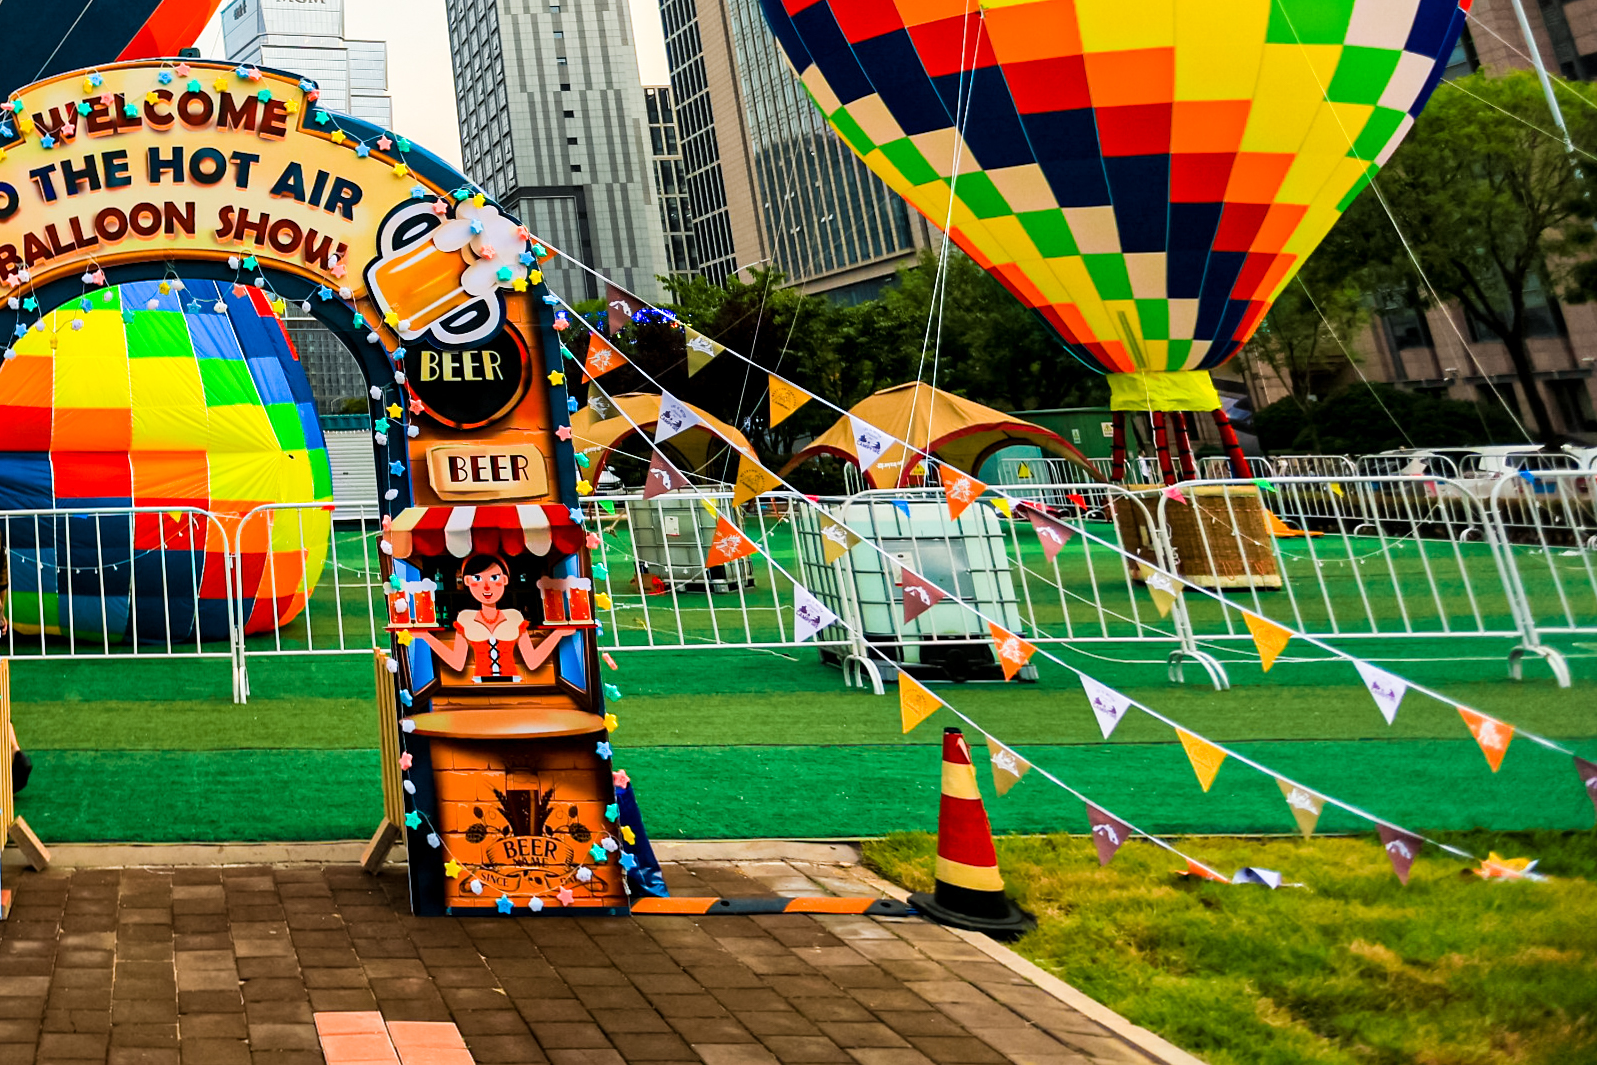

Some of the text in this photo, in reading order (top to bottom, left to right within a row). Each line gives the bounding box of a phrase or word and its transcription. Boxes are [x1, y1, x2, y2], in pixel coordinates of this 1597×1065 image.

[30, 88, 290, 145] WELCOME
[29, 149, 132, 204] THE
[147, 146, 260, 190] HOT
[270, 161, 363, 222] AIR
[420, 350, 503, 382] BEER
[448, 455, 529, 483] BEER
[503, 838, 557, 861] BEER
[480, 872, 508, 887] SINCE
